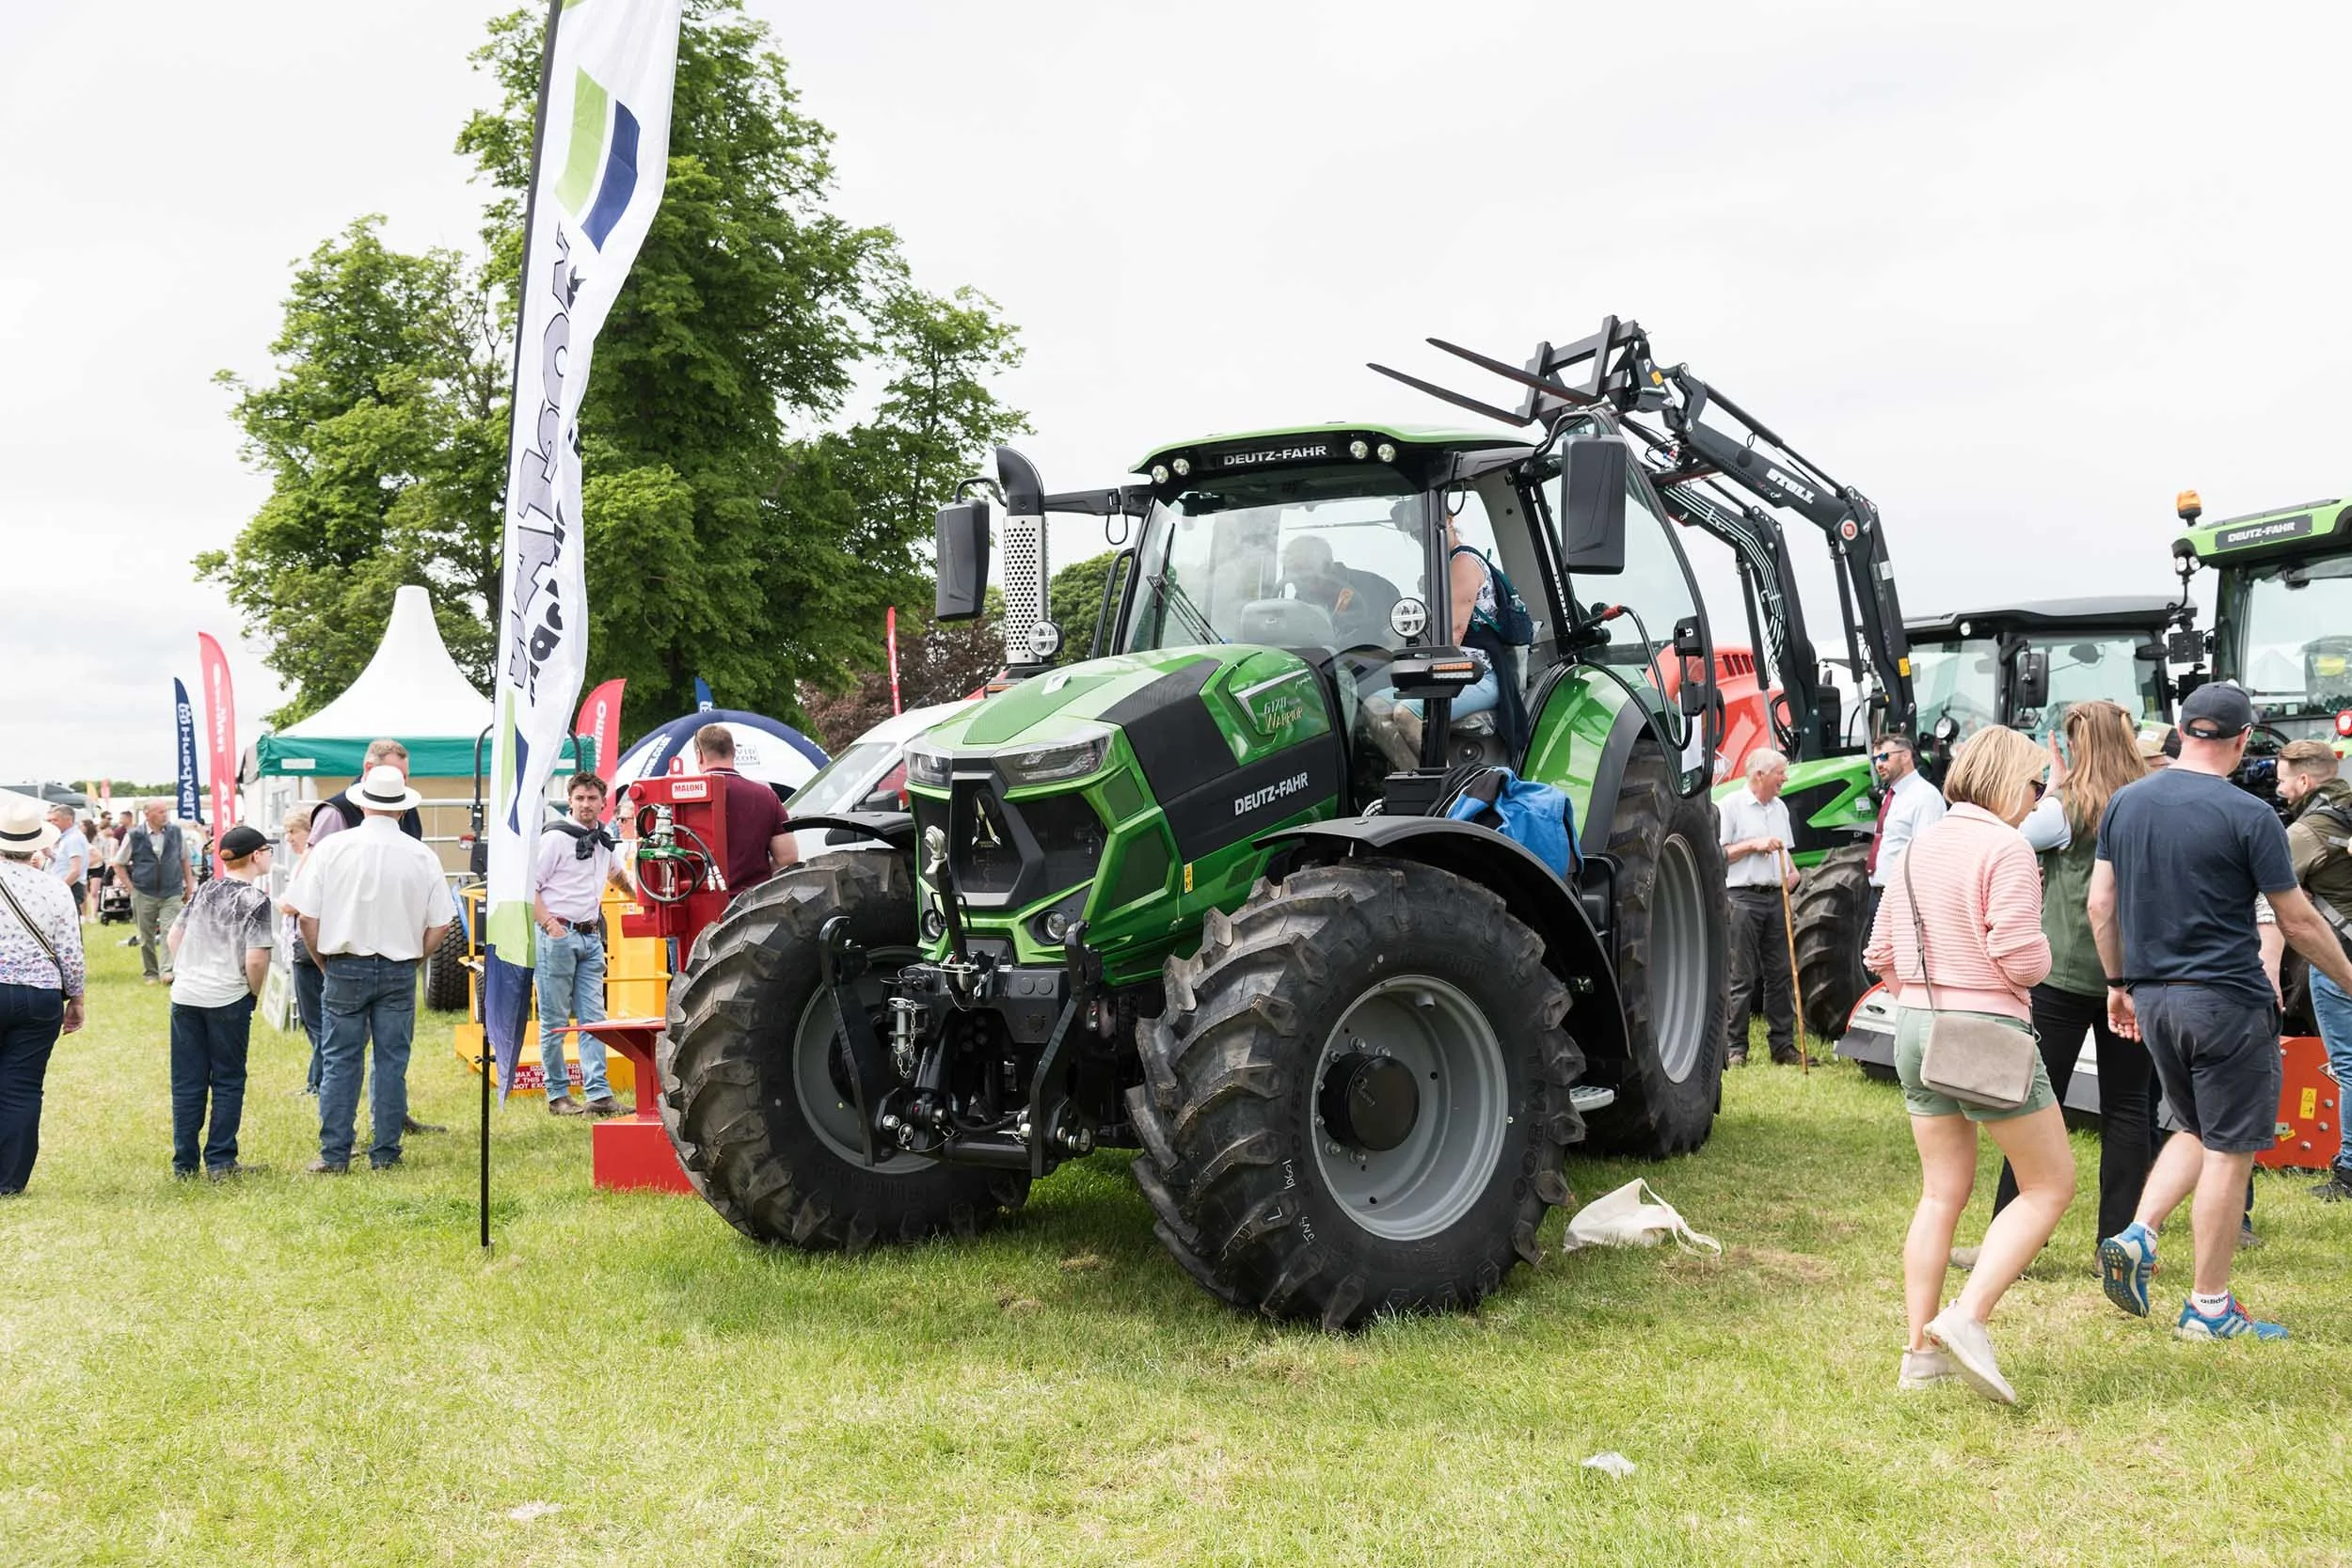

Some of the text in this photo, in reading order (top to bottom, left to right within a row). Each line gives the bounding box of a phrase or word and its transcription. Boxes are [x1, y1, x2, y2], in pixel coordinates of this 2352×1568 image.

[1224, 446, 1327, 466] DEUTZ-FAHR
[1766, 467, 1815, 505] STOLL
[2227, 521, 2296, 543] DEUTZ-FAHR
[180, 725, 196, 820] Husqvarn
[675, 783, 704, 792] MALONE
[1234, 771, 1309, 816] DEUTZ-FAHR
